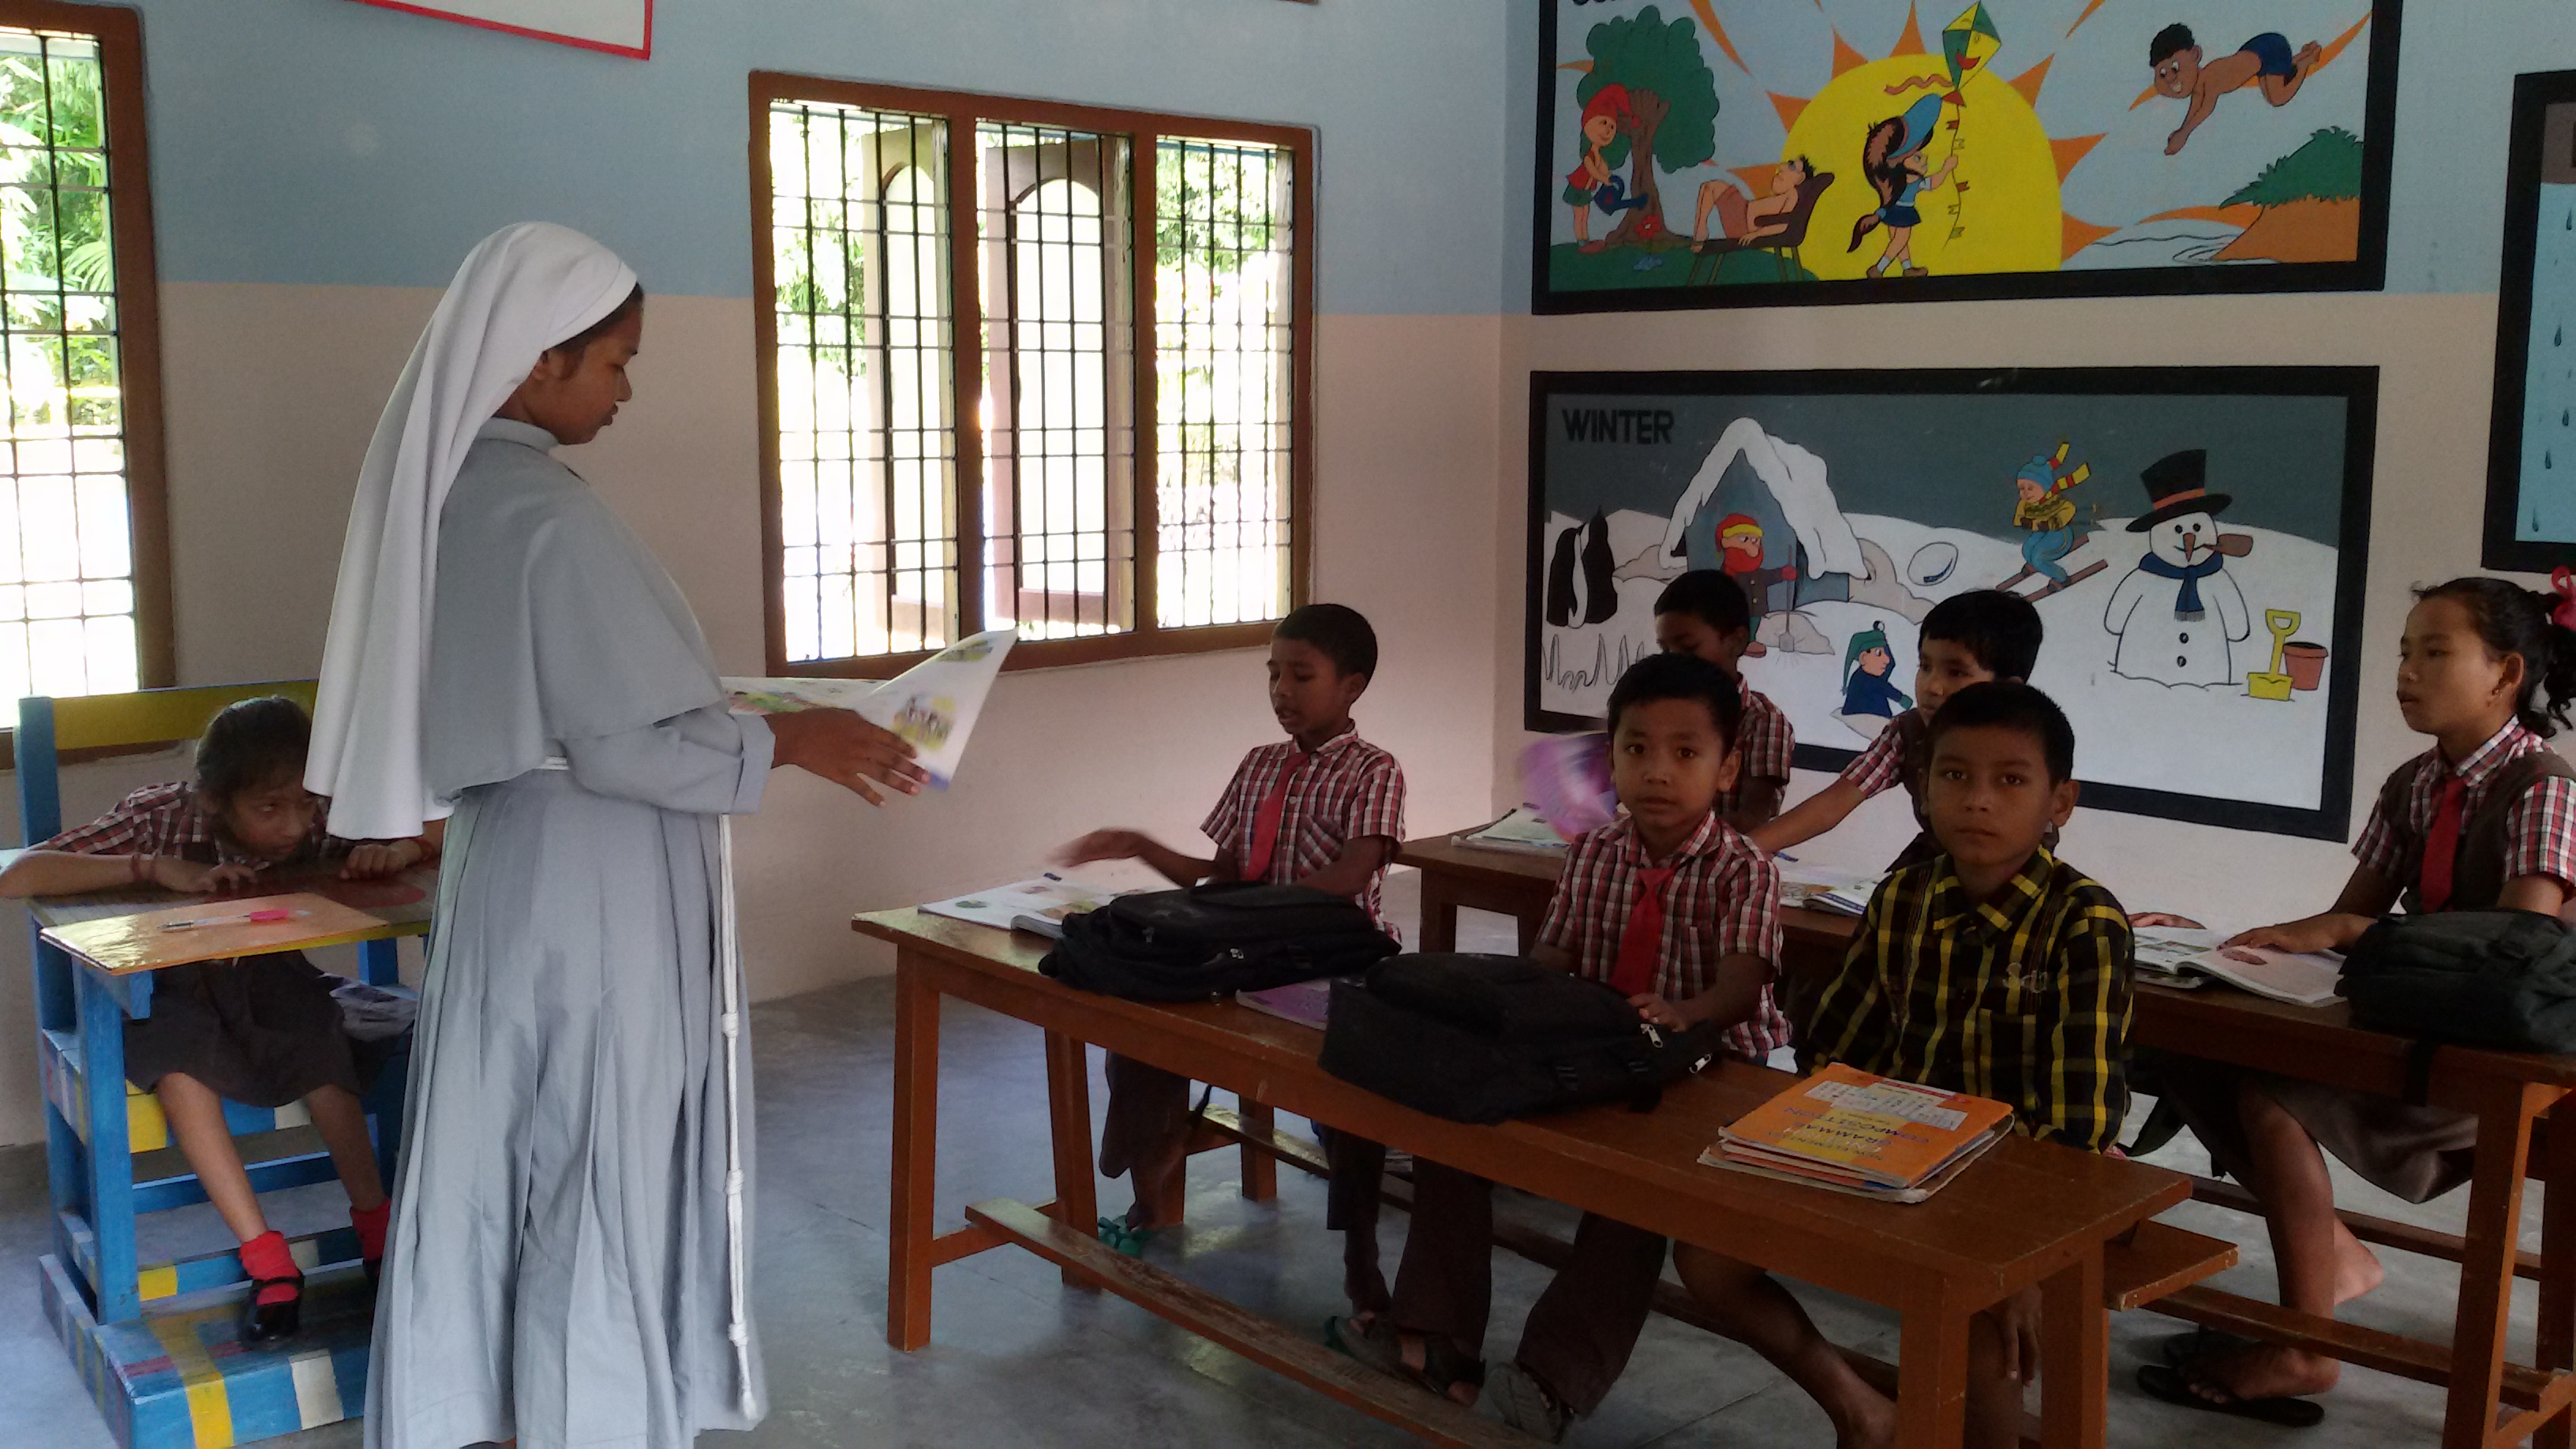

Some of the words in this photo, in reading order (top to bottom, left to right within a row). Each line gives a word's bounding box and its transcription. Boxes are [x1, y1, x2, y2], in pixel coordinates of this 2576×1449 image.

[1563, 409, 1675, 444] WINTER
[1783, 1106, 1930, 1144] COMPOSITION
[1792, 1121, 1891, 1145] GRAMMAR
[1782, 1126, 1881, 1152] ENGLISH
[1852, 1150, 1884, 1160] NEW
